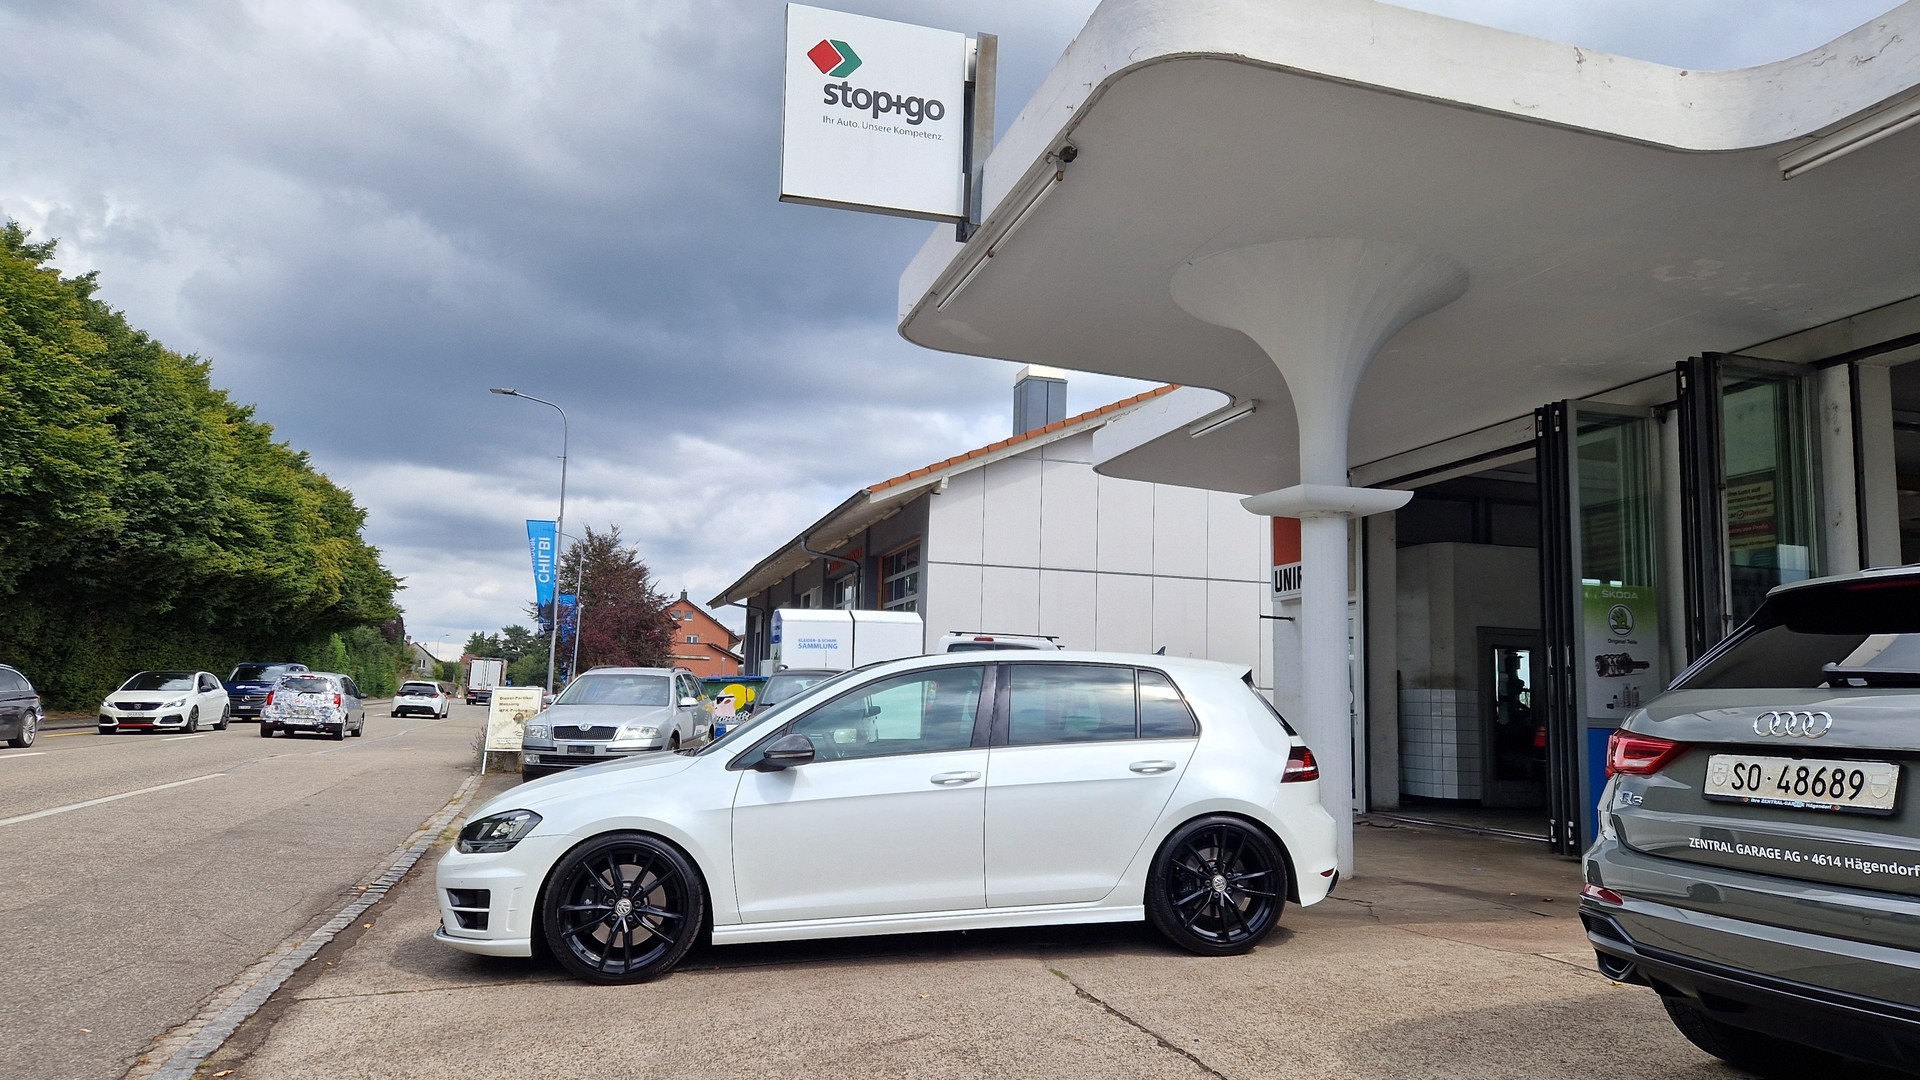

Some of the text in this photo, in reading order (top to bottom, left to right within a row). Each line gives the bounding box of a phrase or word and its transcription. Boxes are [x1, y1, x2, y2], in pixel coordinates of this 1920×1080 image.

[823, 81, 945, 125] stop+go
[822, 115, 945, 141] Ihr Auto. Unsere Kompetenz.
[1620, 791, 1643, 806] Q3
[1689, 837, 1920, 877] ZENTRAL GARAGE AG 4614 Hägendorf
